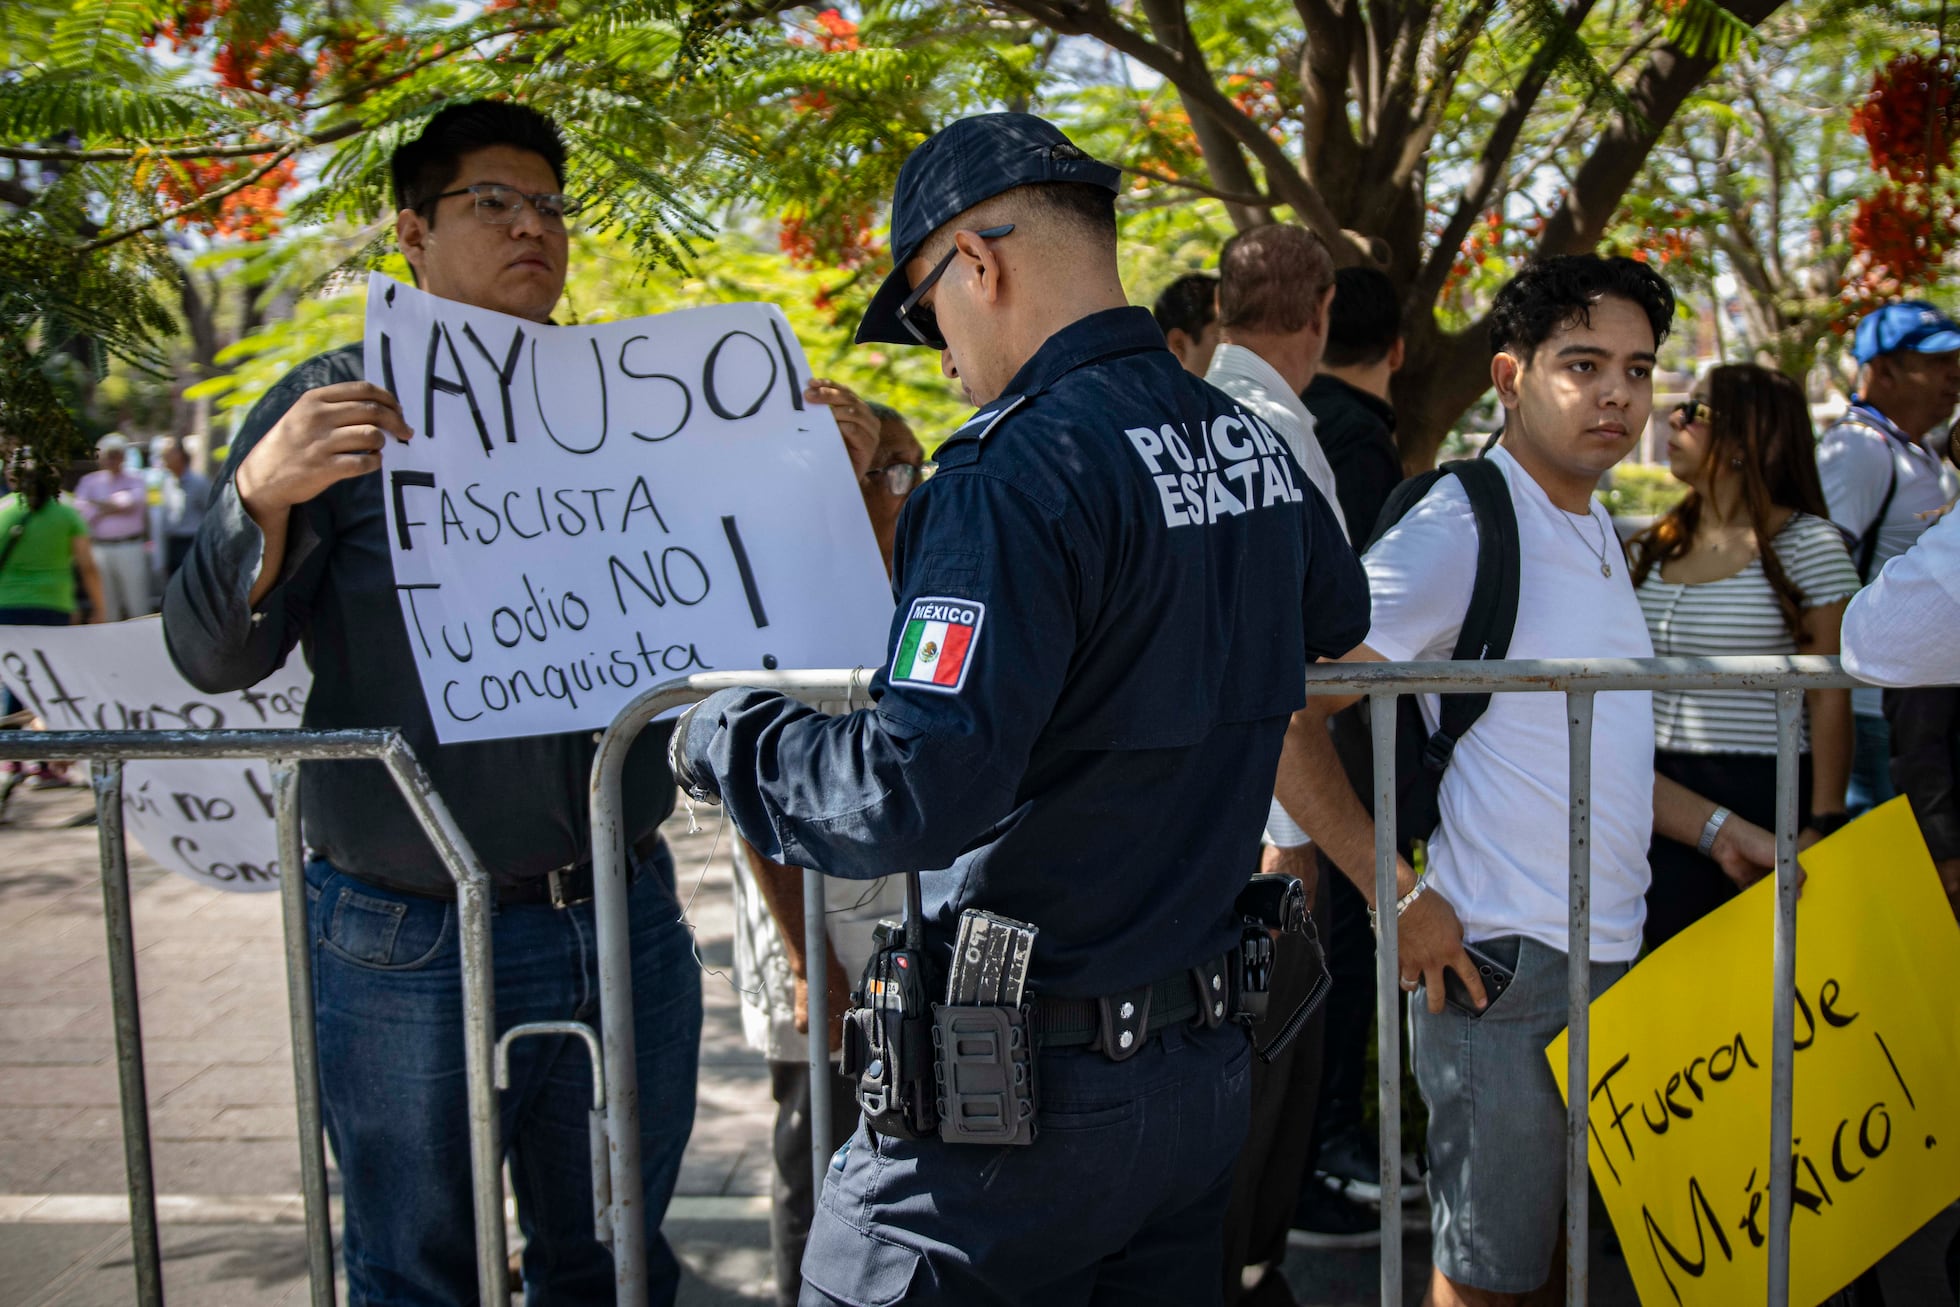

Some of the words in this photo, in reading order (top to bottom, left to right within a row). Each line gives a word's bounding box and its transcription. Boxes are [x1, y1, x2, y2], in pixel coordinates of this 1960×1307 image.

[391, 470, 670, 550] FASCISTA
[1153, 455, 1303, 528] ESATAL
[395, 583, 474, 662] Tu
[491, 573, 590, 647] odio
[912, 602, 975, 625] MÉXICO
[443, 631, 714, 723] conquista
